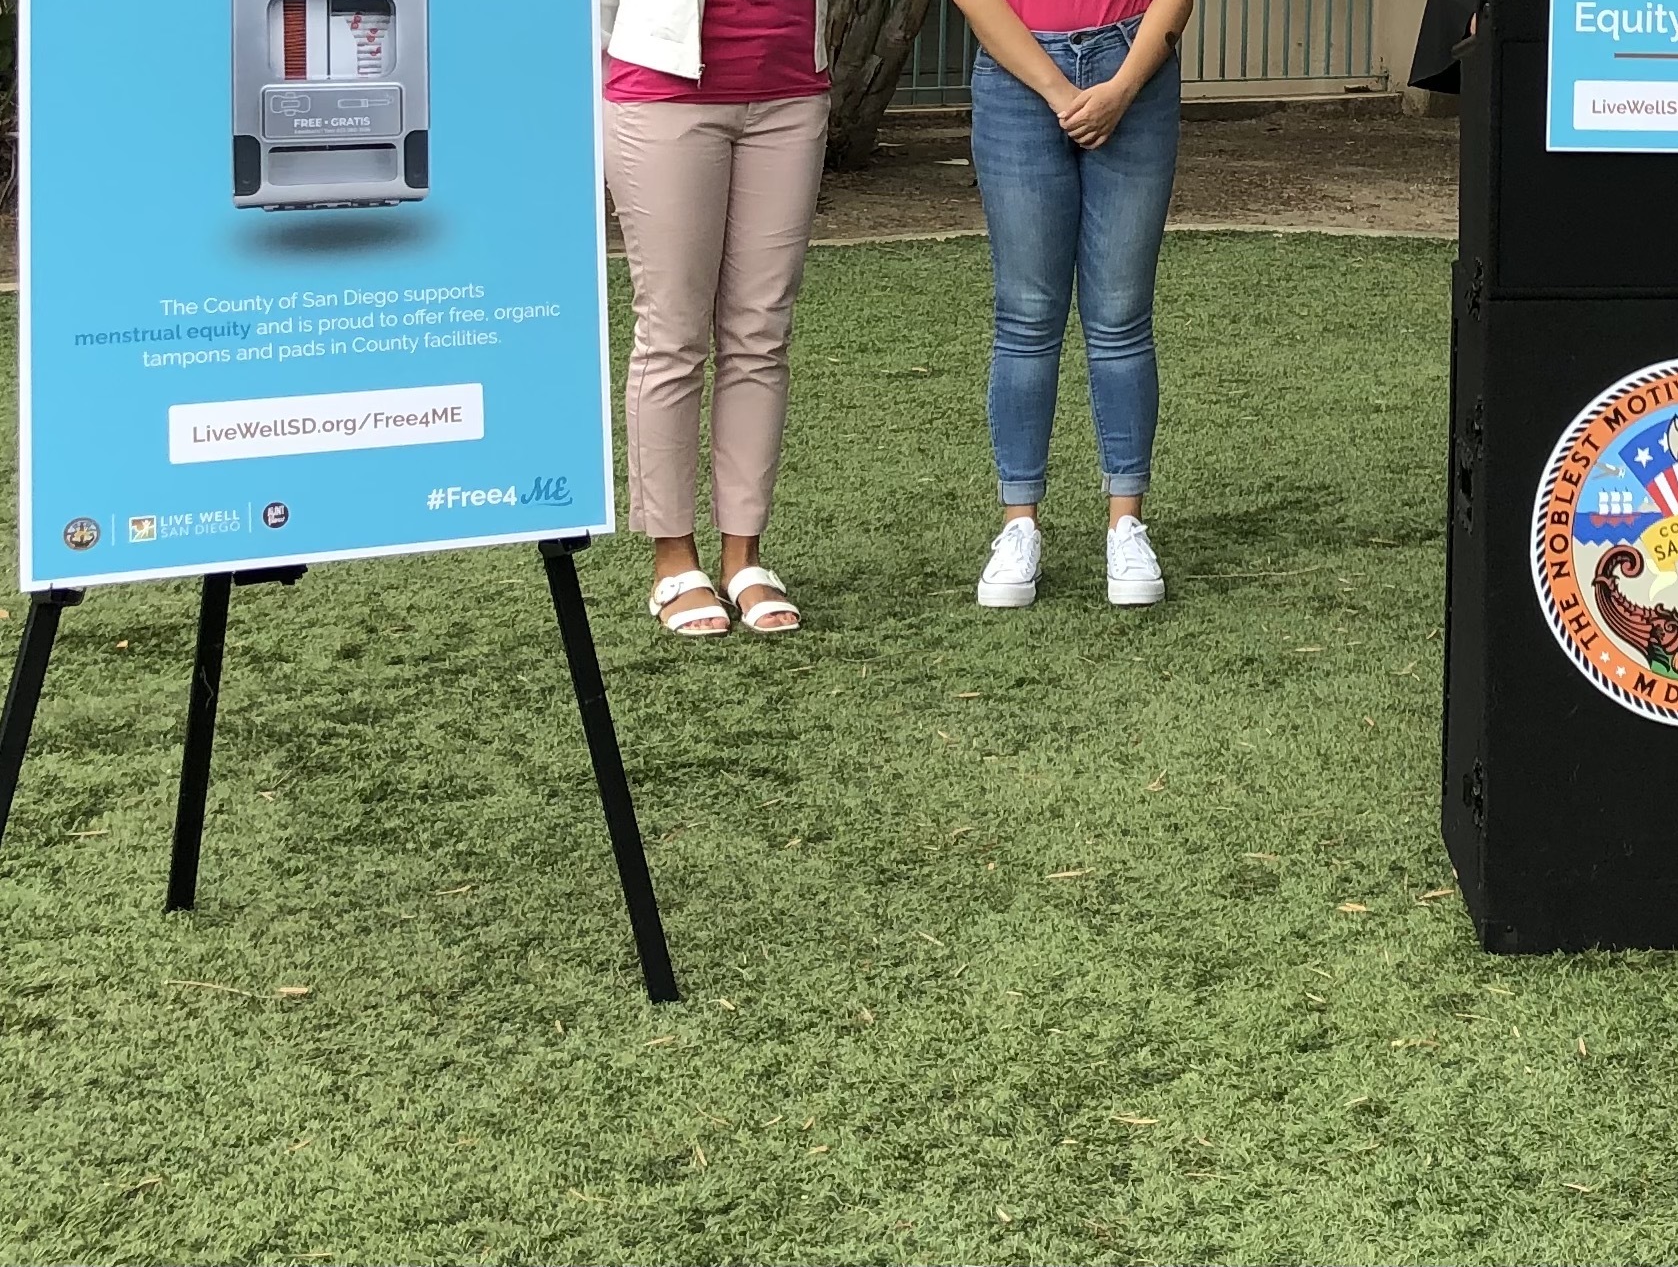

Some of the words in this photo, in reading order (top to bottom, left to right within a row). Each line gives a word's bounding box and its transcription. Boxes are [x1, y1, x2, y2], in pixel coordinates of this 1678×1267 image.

[293, 118, 322, 128] FREE
[330, 116, 371, 127] GRATIS
[160, 298, 198, 316] The
[203, 295, 273, 315] County
[278, 292, 298, 308] of
[303, 291, 338, 307] San
[343, 288, 399, 310] Diego
[403, 283, 484, 305] supports
[74, 324, 181, 346] menstrual
[186, 321, 250, 343] equity
[256, 318, 293, 335] and
[298, 317, 313, 333] is
[318, 312, 374, 337] proud
[379, 312, 398, 328] to
[403, 307, 443, 325] offer
[494, 302, 560, 322] organic
[143, 348, 230, 369] tampons
[236, 344, 273, 361] and
[278, 340, 324, 363] pads
[330, 339, 346, 355] in
[352, 334, 419, 356] County
[423, 330, 502, 348] facilities.
[192, 406, 462, 444] LiveWellSD.org/Free4ME
[160, 513, 193, 527] LIVE
[199, 509, 240, 524] WELL
[1550, 435, 1601, 578] NOBLEST
[160, 524, 191, 538] SAN
[194, 521, 241, 535] DIEGO
[1559, 592, 1600, 651] THE
